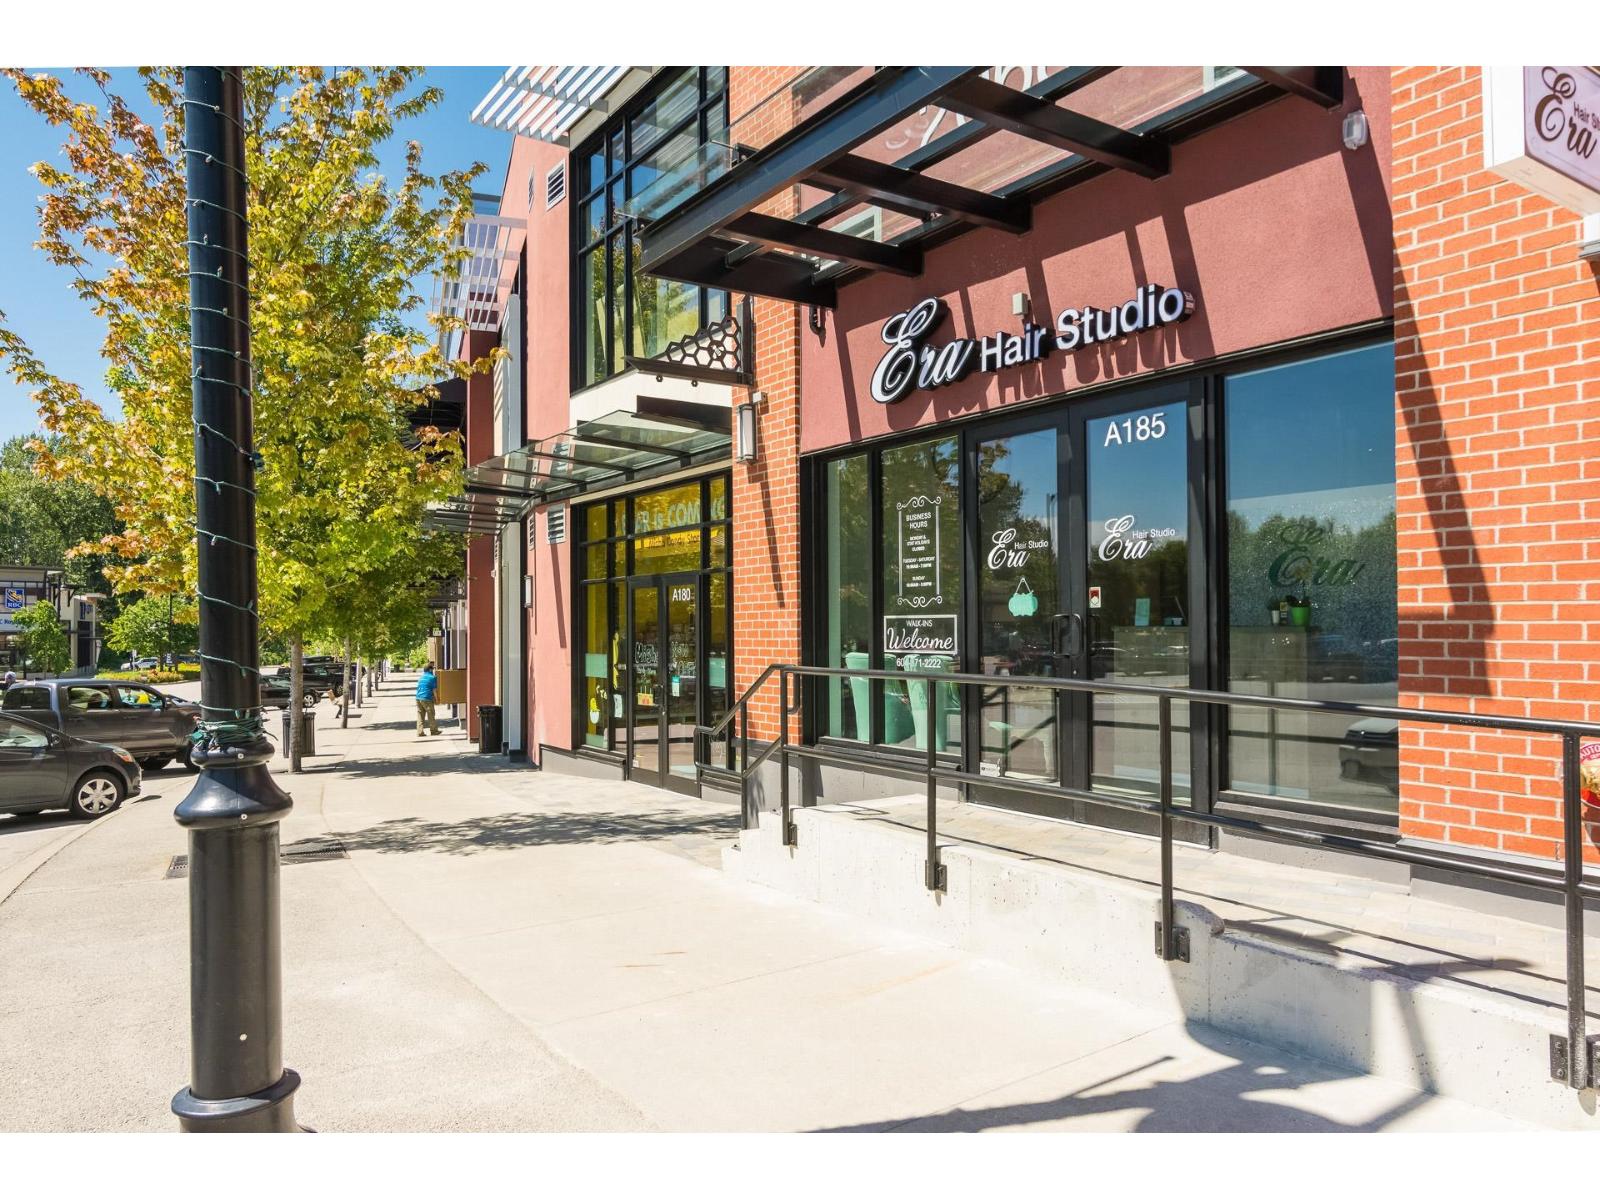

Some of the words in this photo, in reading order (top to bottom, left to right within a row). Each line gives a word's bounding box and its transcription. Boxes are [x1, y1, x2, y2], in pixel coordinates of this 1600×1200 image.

[1534, 66, 1598, 159] Era
[1573, 101, 1590, 123] Hair
[870, 297, 975, 404] Era
[980, 322, 1047, 372] Hair
[1055, 283, 1186, 351] Studio
[1104, 412, 1166, 447] A185
[906, 512, 932, 522] BUSINESS
[909, 521, 928, 529] HOURS
[987, 528, 1030, 570] Era
[1014, 541, 1027, 550] Hair
[1028, 539, 1049, 549] Studio
[1099, 514, 1153, 562] Era
[1132, 529, 1149, 539] Hair
[1150, 528, 1176, 538] Studio
[672, 588, 692, 602] A180
[905, 619, 933, 627] WALK-INS
[887, 627, 953, 650] Welcome
